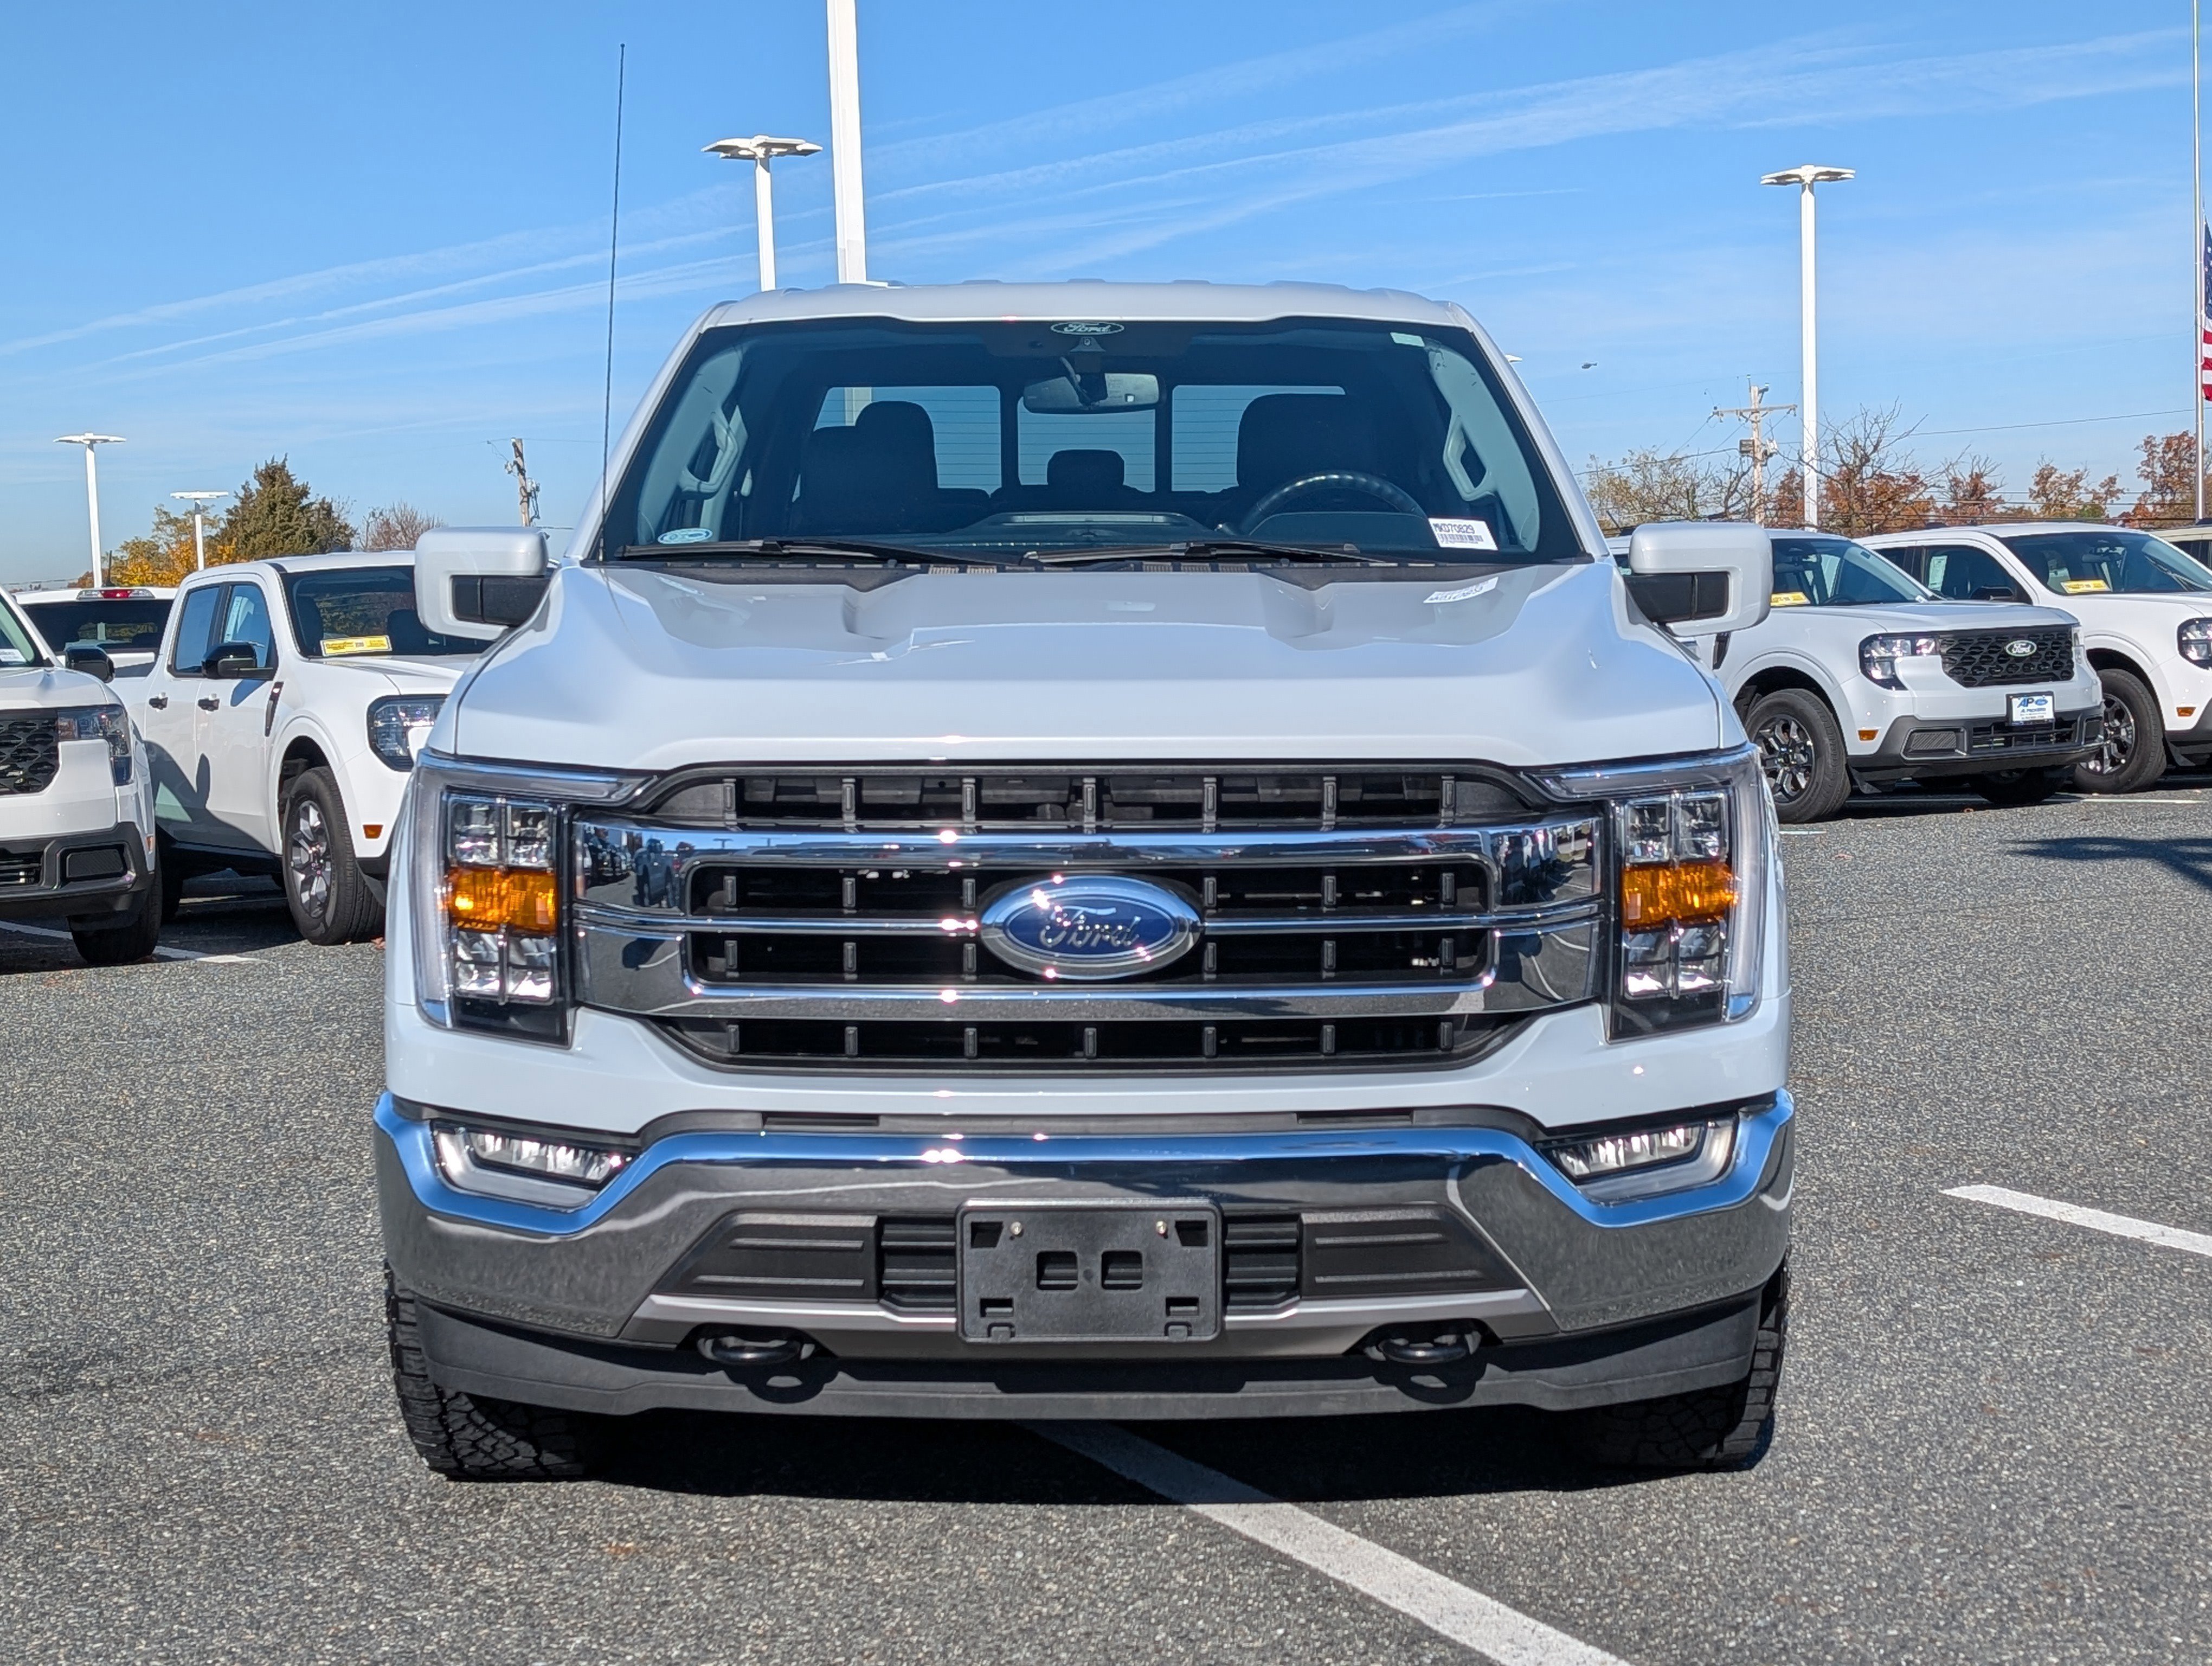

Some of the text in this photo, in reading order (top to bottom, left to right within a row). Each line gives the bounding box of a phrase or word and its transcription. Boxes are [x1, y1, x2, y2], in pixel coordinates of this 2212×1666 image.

[1063, 322, 1111, 332] Ford
[2011, 643, 2031, 654] Ford
[2017, 698, 2034, 708] AP
[1039, 905, 1142, 949] Ford
